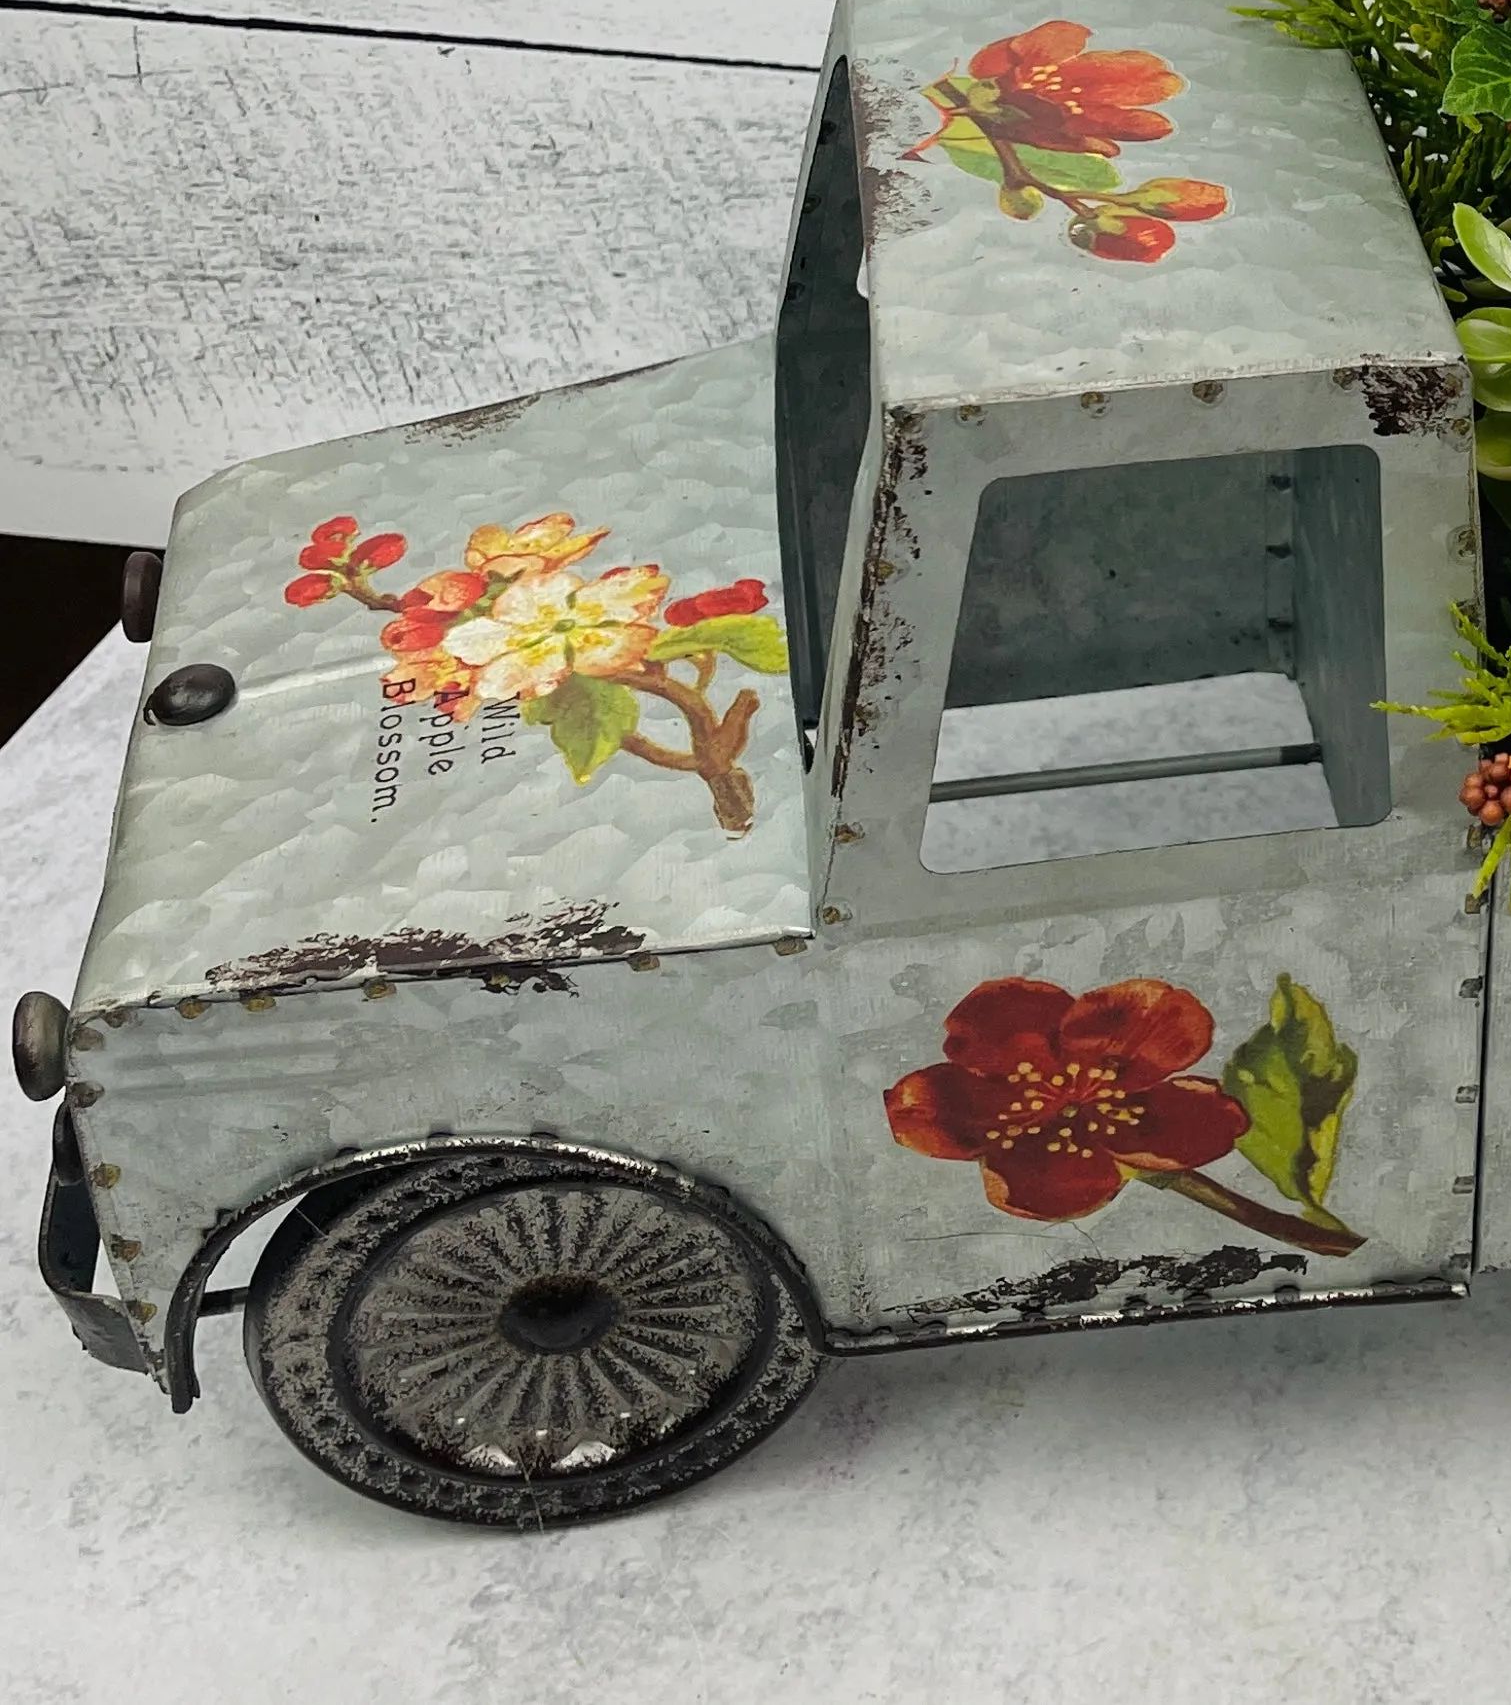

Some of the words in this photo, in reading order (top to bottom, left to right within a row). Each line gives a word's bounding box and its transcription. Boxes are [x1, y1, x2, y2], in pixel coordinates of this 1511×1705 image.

[371, 678, 416, 823] Blossom.
[418, 689, 470, 775] Apple
[481, 691, 520, 764] Wild
